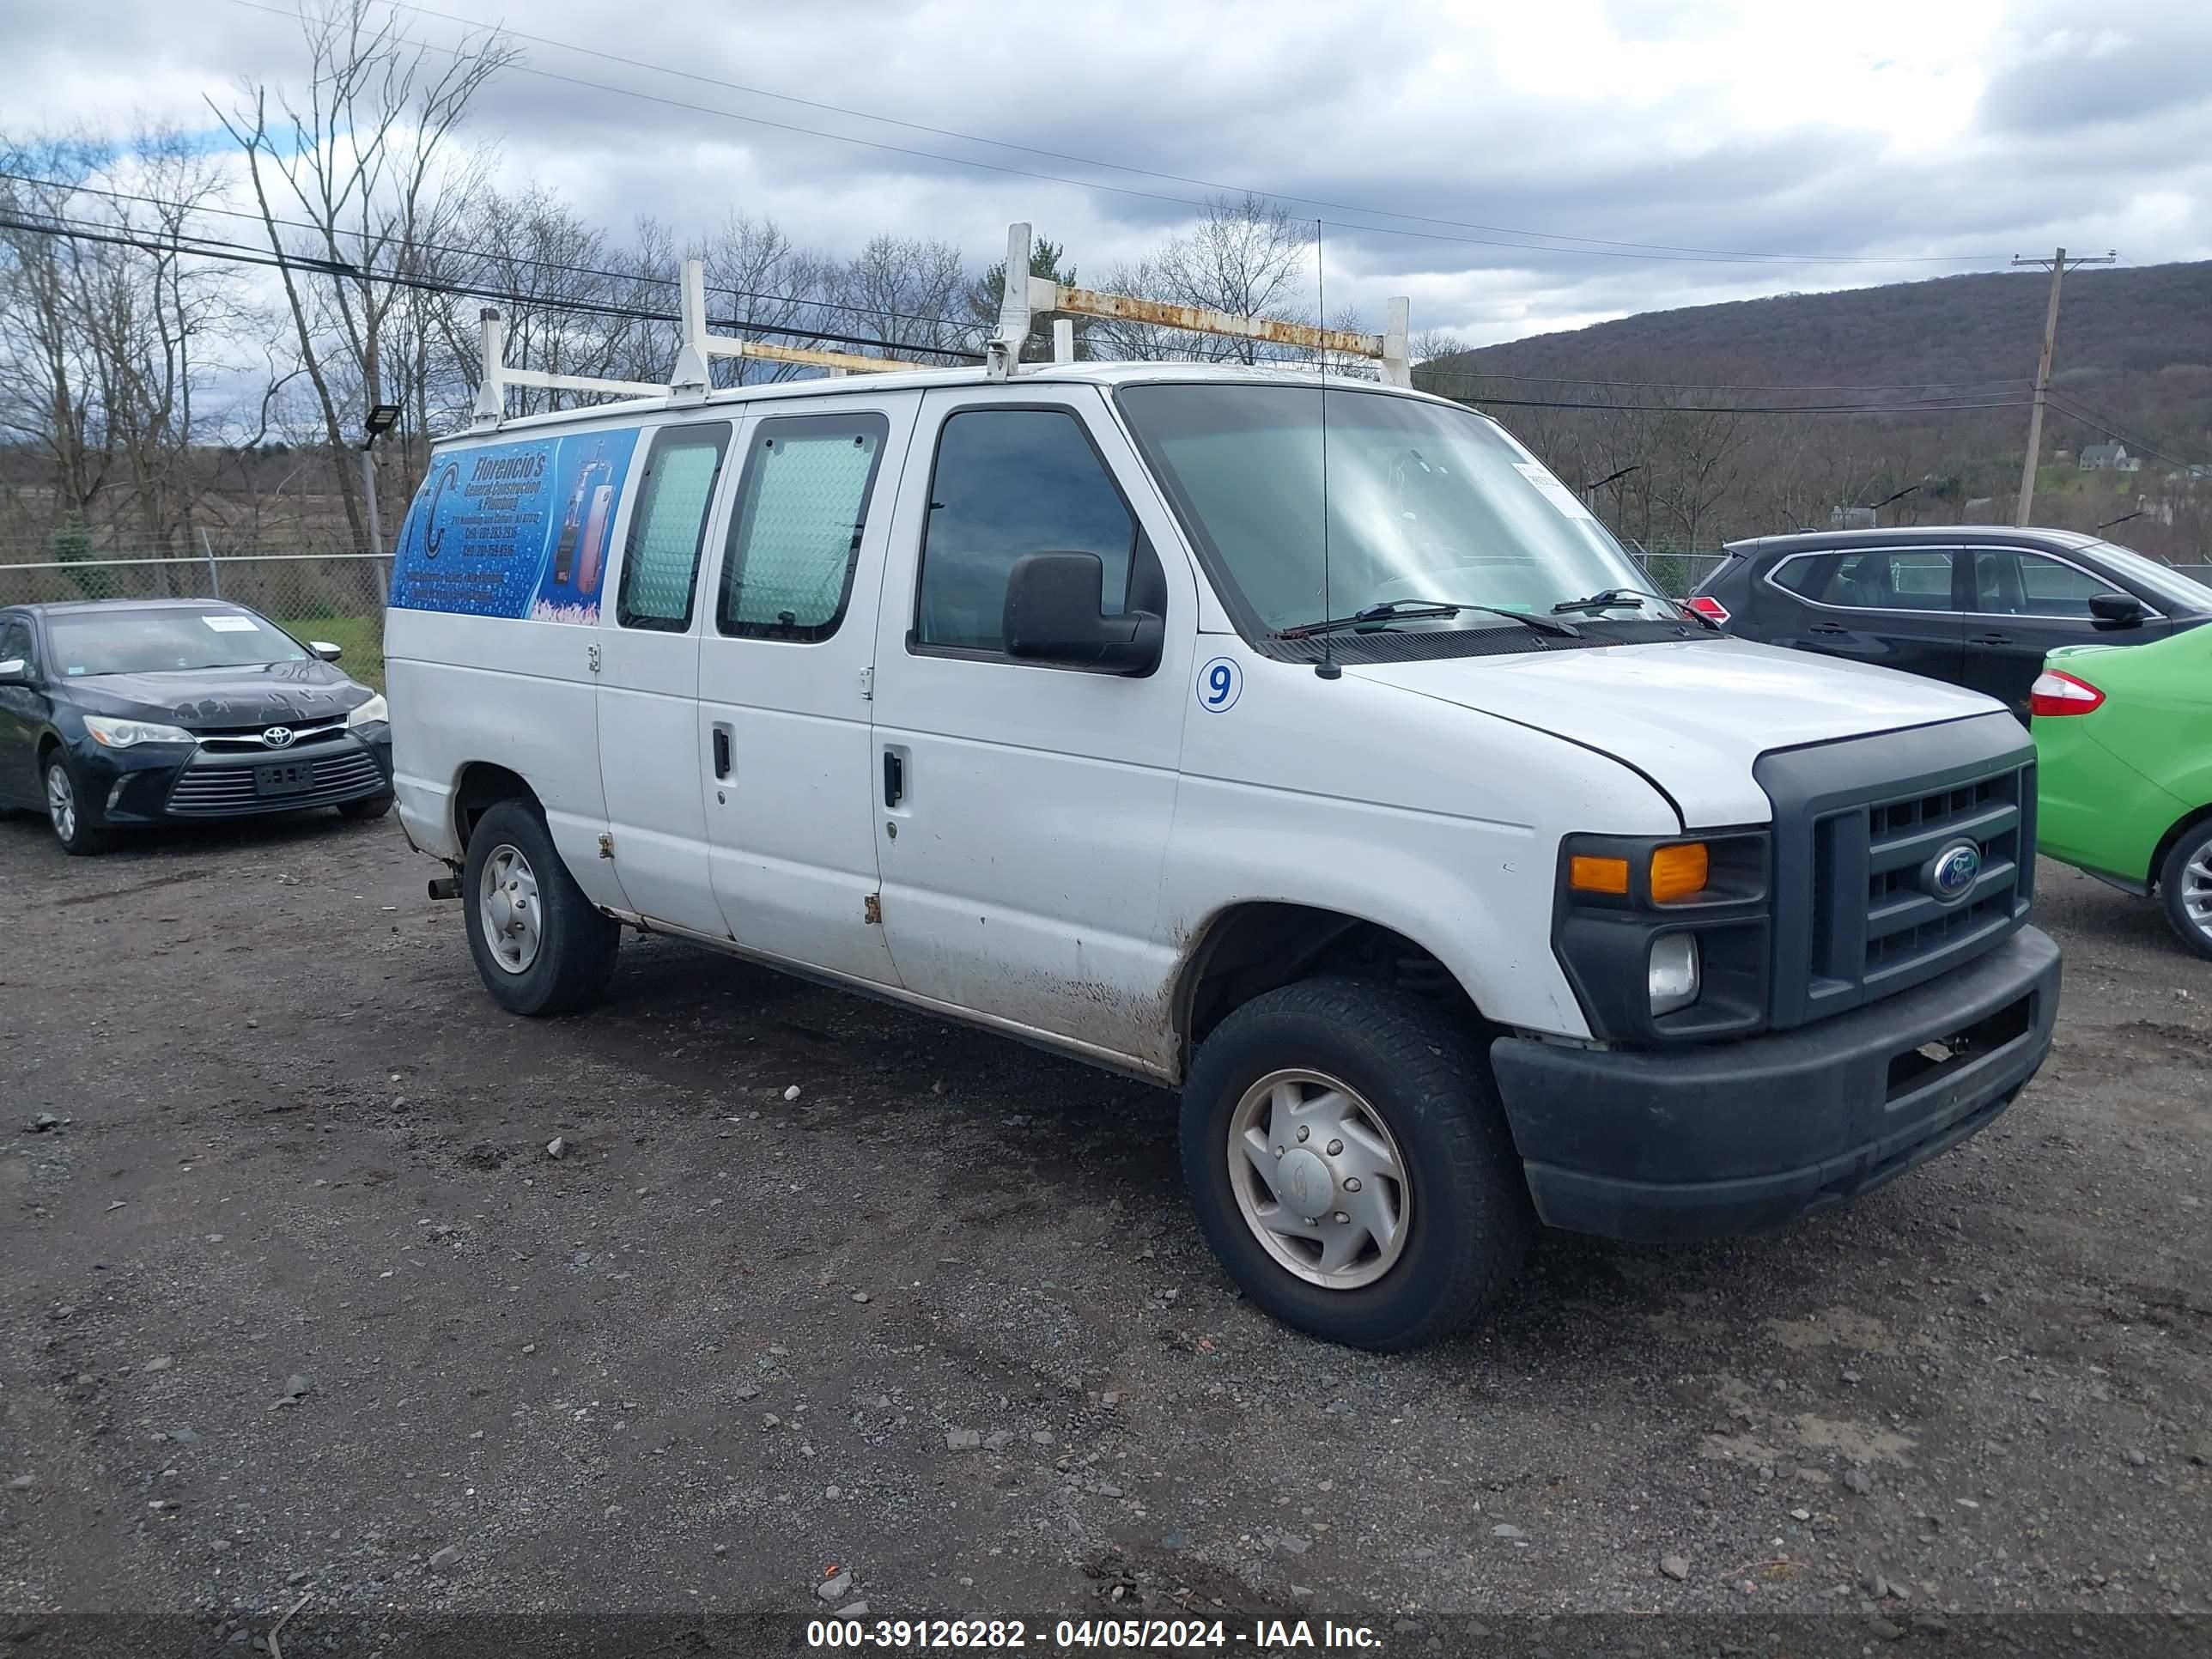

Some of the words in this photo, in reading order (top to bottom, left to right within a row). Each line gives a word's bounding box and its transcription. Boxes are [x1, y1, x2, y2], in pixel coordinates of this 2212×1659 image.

[471, 452, 546, 481] Florencio's
[465, 482, 494, 497] General
[493, 480, 542, 495] Construction
[483, 496, 519, 511] Plumbing
[1207, 665, 1231, 704] 9
